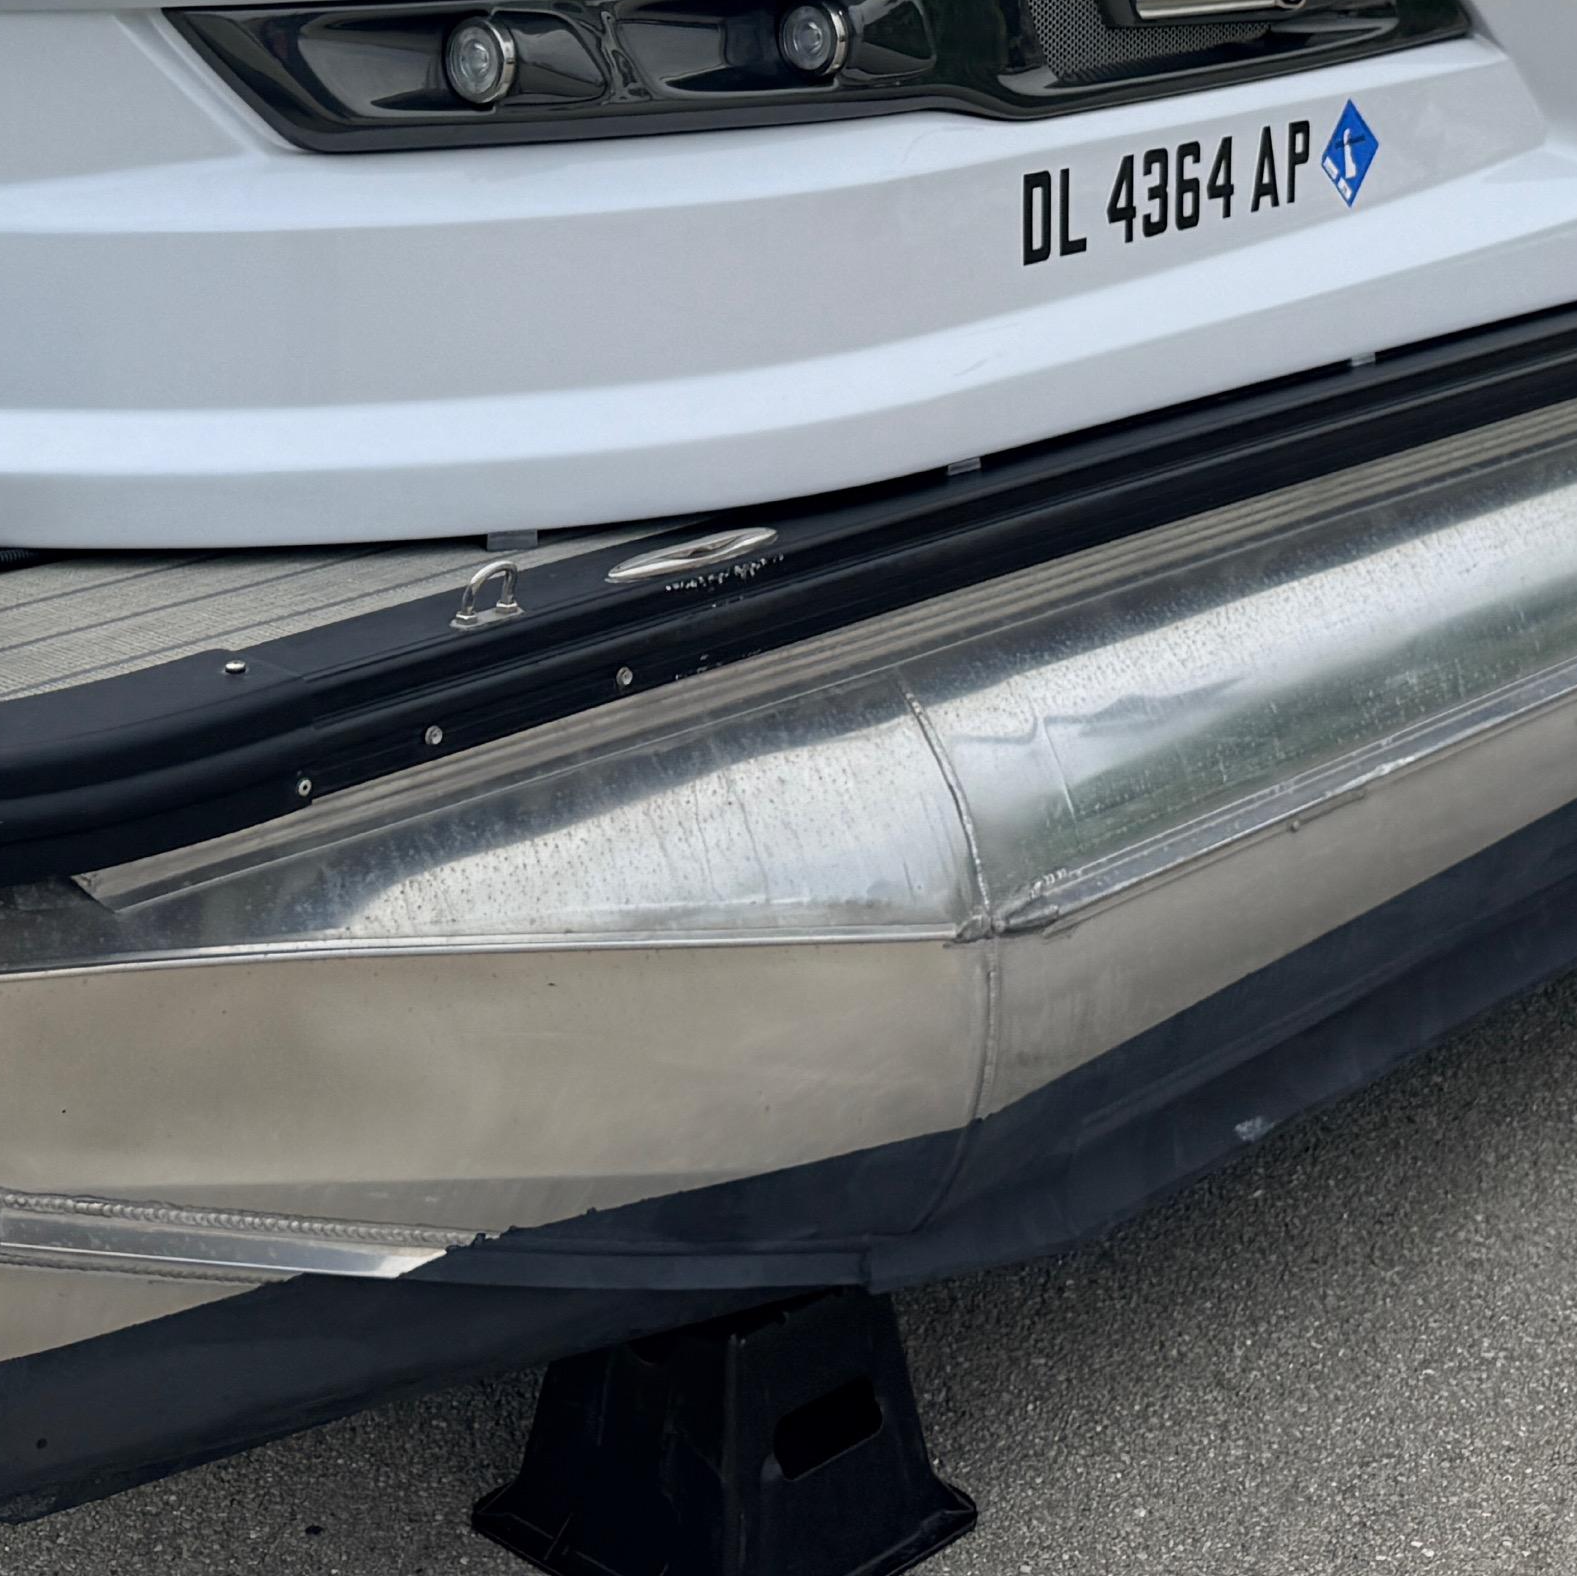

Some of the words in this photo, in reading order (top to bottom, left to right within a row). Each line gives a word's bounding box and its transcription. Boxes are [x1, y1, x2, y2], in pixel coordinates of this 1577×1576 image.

[1023, 168, 1087, 266] DL
[1107, 135, 1235, 243] 4364
[1251, 120, 1310, 213] AP
